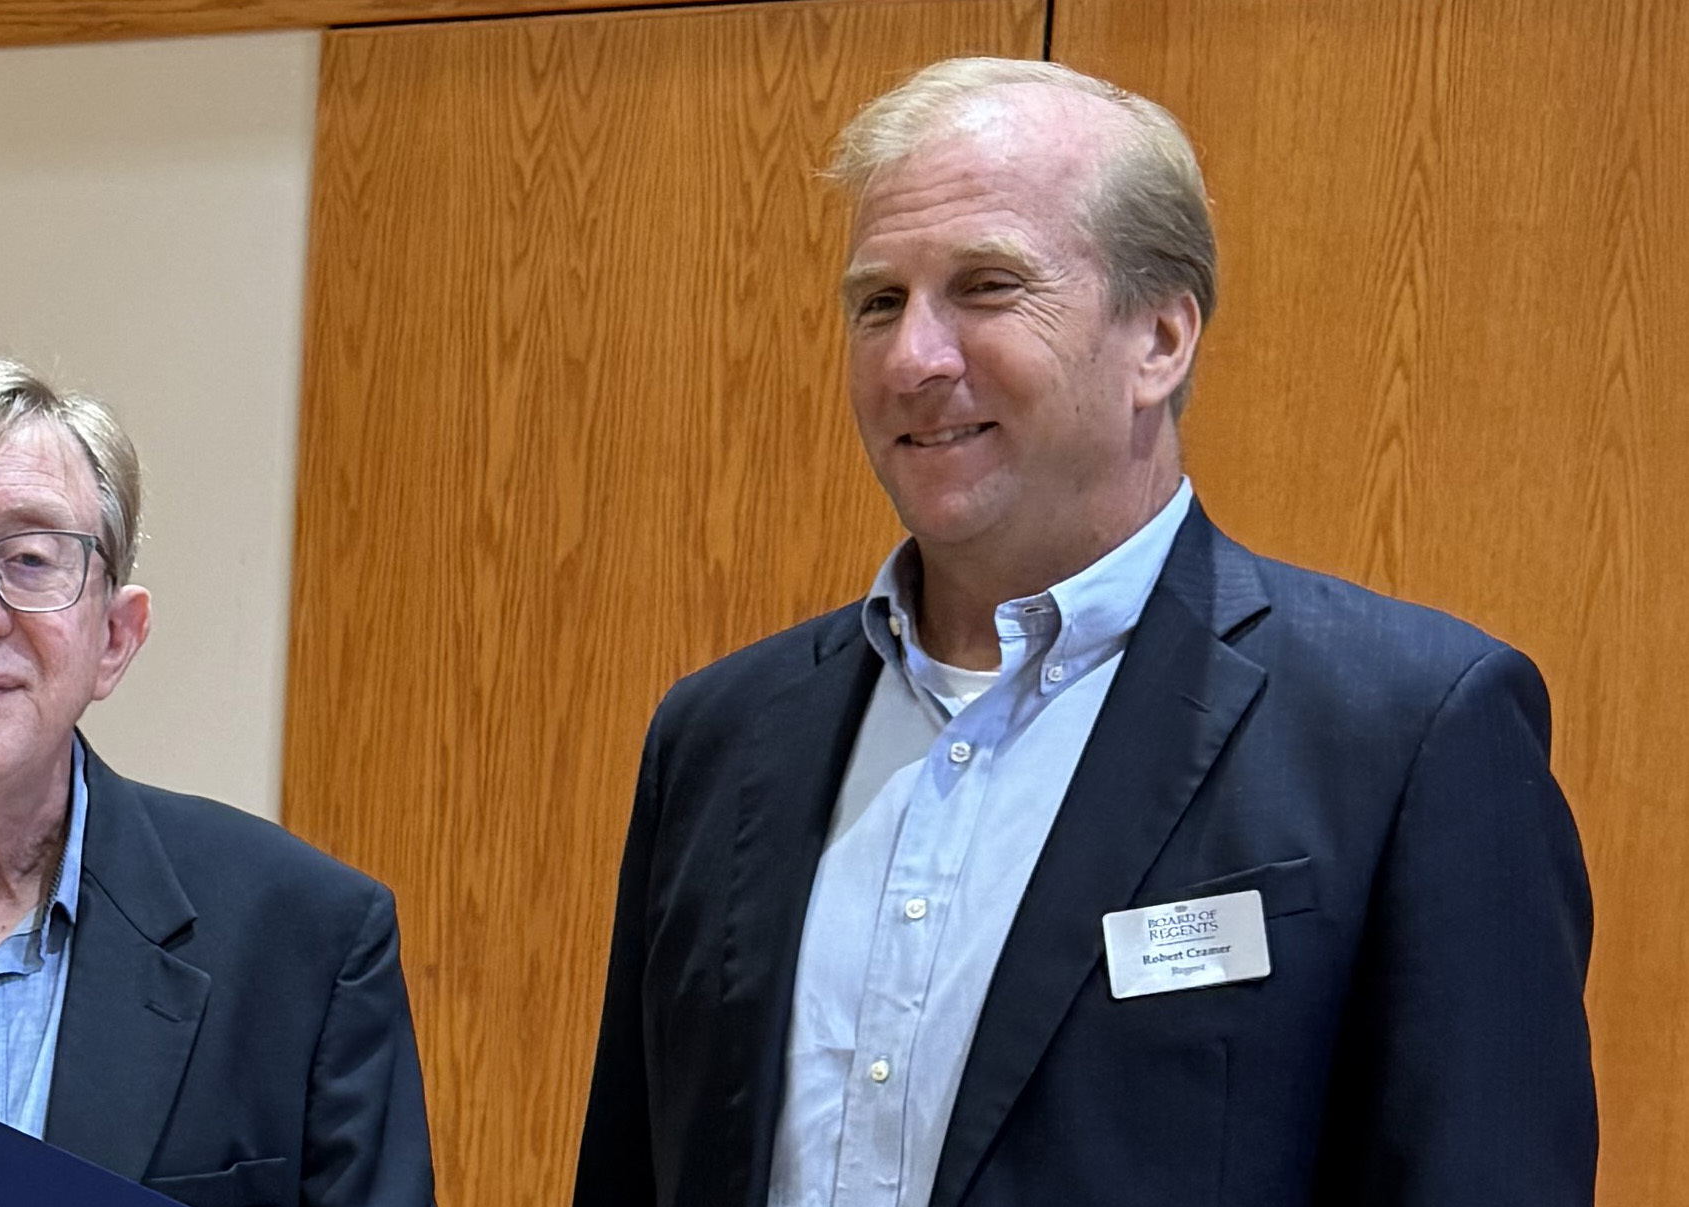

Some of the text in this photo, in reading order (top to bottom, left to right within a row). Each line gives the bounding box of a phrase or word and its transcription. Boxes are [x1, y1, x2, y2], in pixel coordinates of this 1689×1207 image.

[1148, 909, 1217, 928] BOARD OF
[1149, 920, 1219, 941] REGENTS
[1142, 951, 1184, 965] Robert
